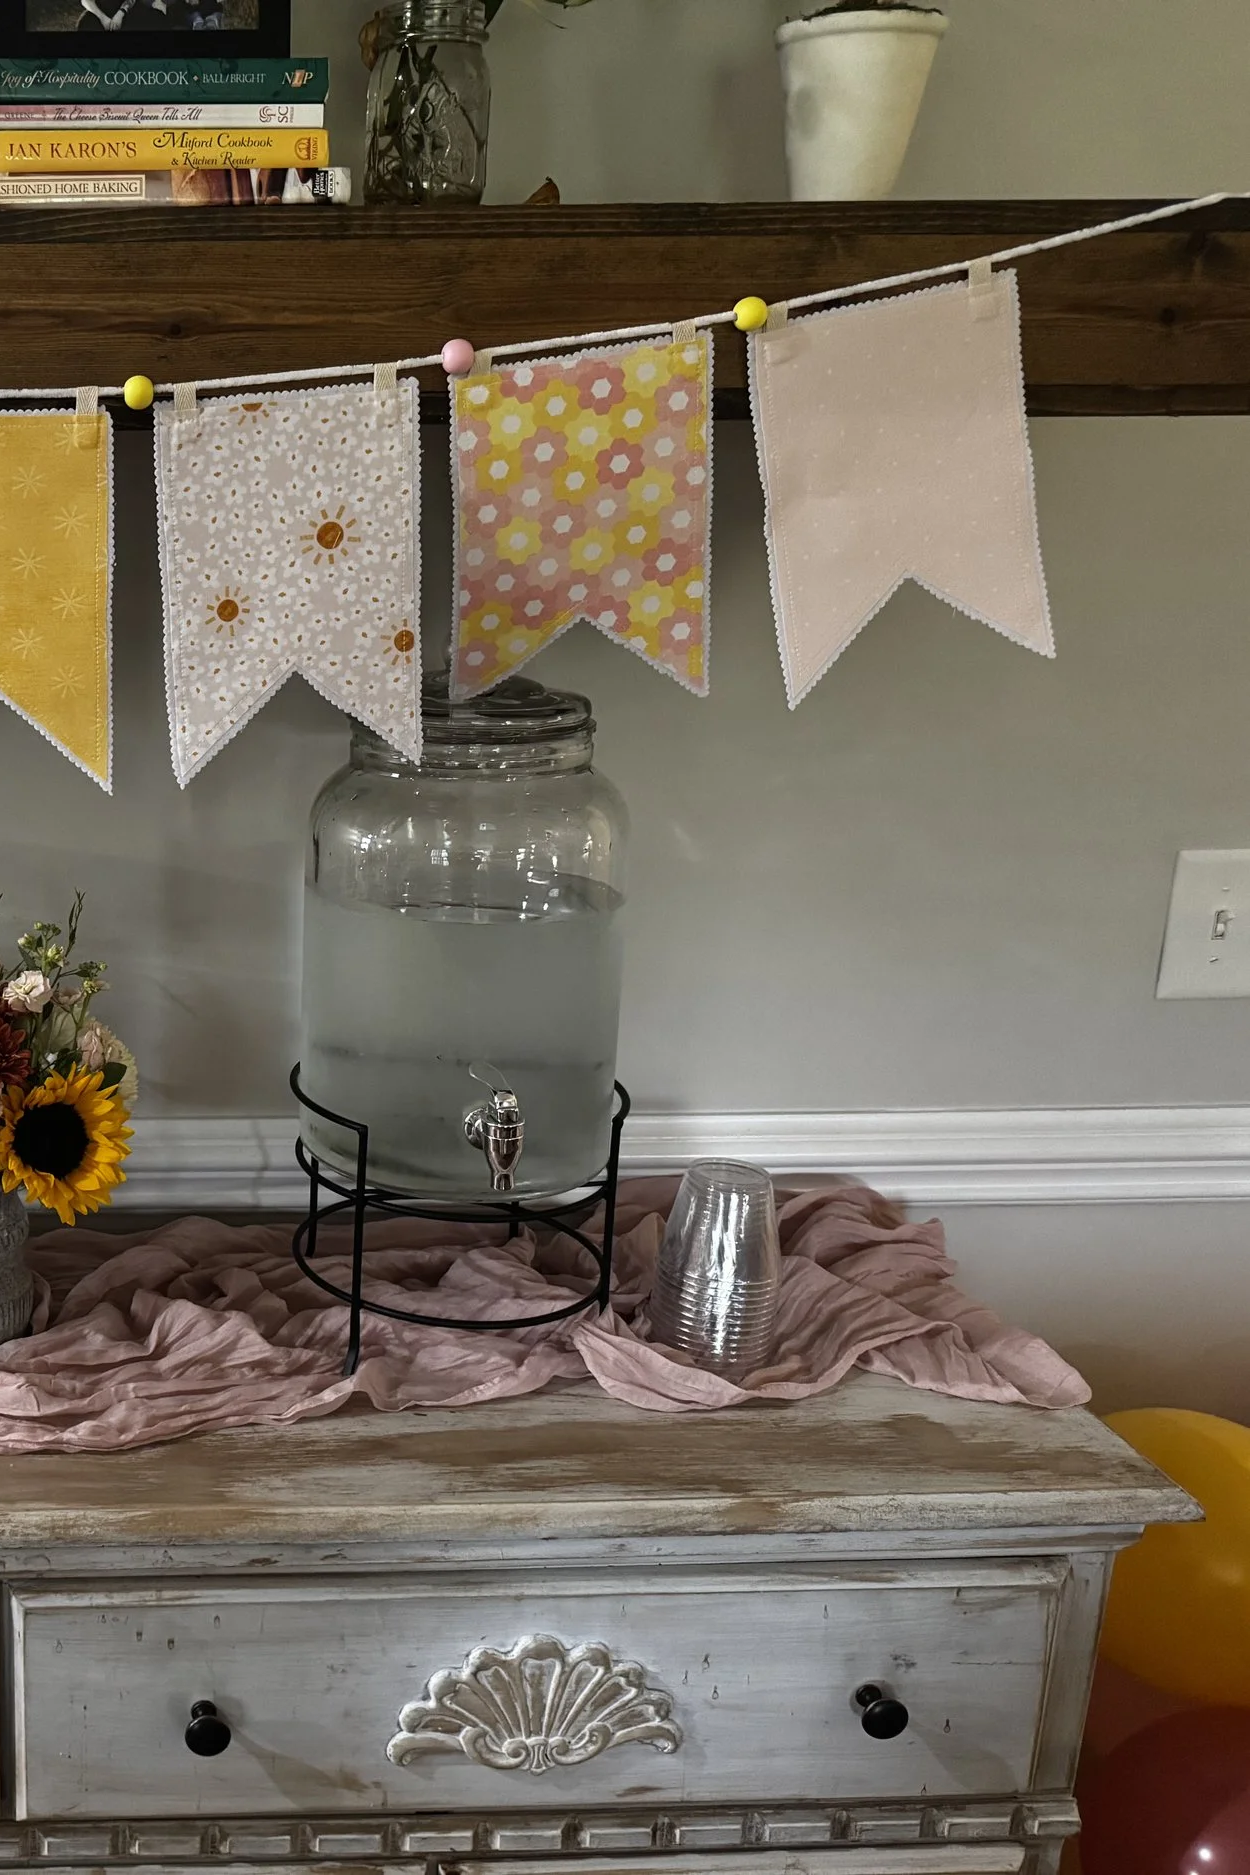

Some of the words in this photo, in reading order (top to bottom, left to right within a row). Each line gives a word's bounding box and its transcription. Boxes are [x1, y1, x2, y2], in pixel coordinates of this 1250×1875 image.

[22, 70, 37, 88] of
[37, 69, 100, 88] Hospitality
[104, 71, 189, 85] COOKBOOK
[51, 107, 66, 121] The
[69, 106, 96, 121] Cheese
[100, 107, 129, 121] Biscuit
[132, 107, 159, 123] Queen
[161, 107, 179, 121] Tells
[181, 106, 202, 121] All
[153, 132, 213, 149] Mitford
[217, 133, 273, 148] Cookbook
[8, 143, 42, 158] JAN
[50, 142, 137, 158] KARON'S
[171, 158, 179, 166] &
[182, 152, 217, 168] Kitchen
[220, 151, 256, 168] Reader
[54, 183, 89, 194] HOME
[93, 181, 138, 194] BAKING
